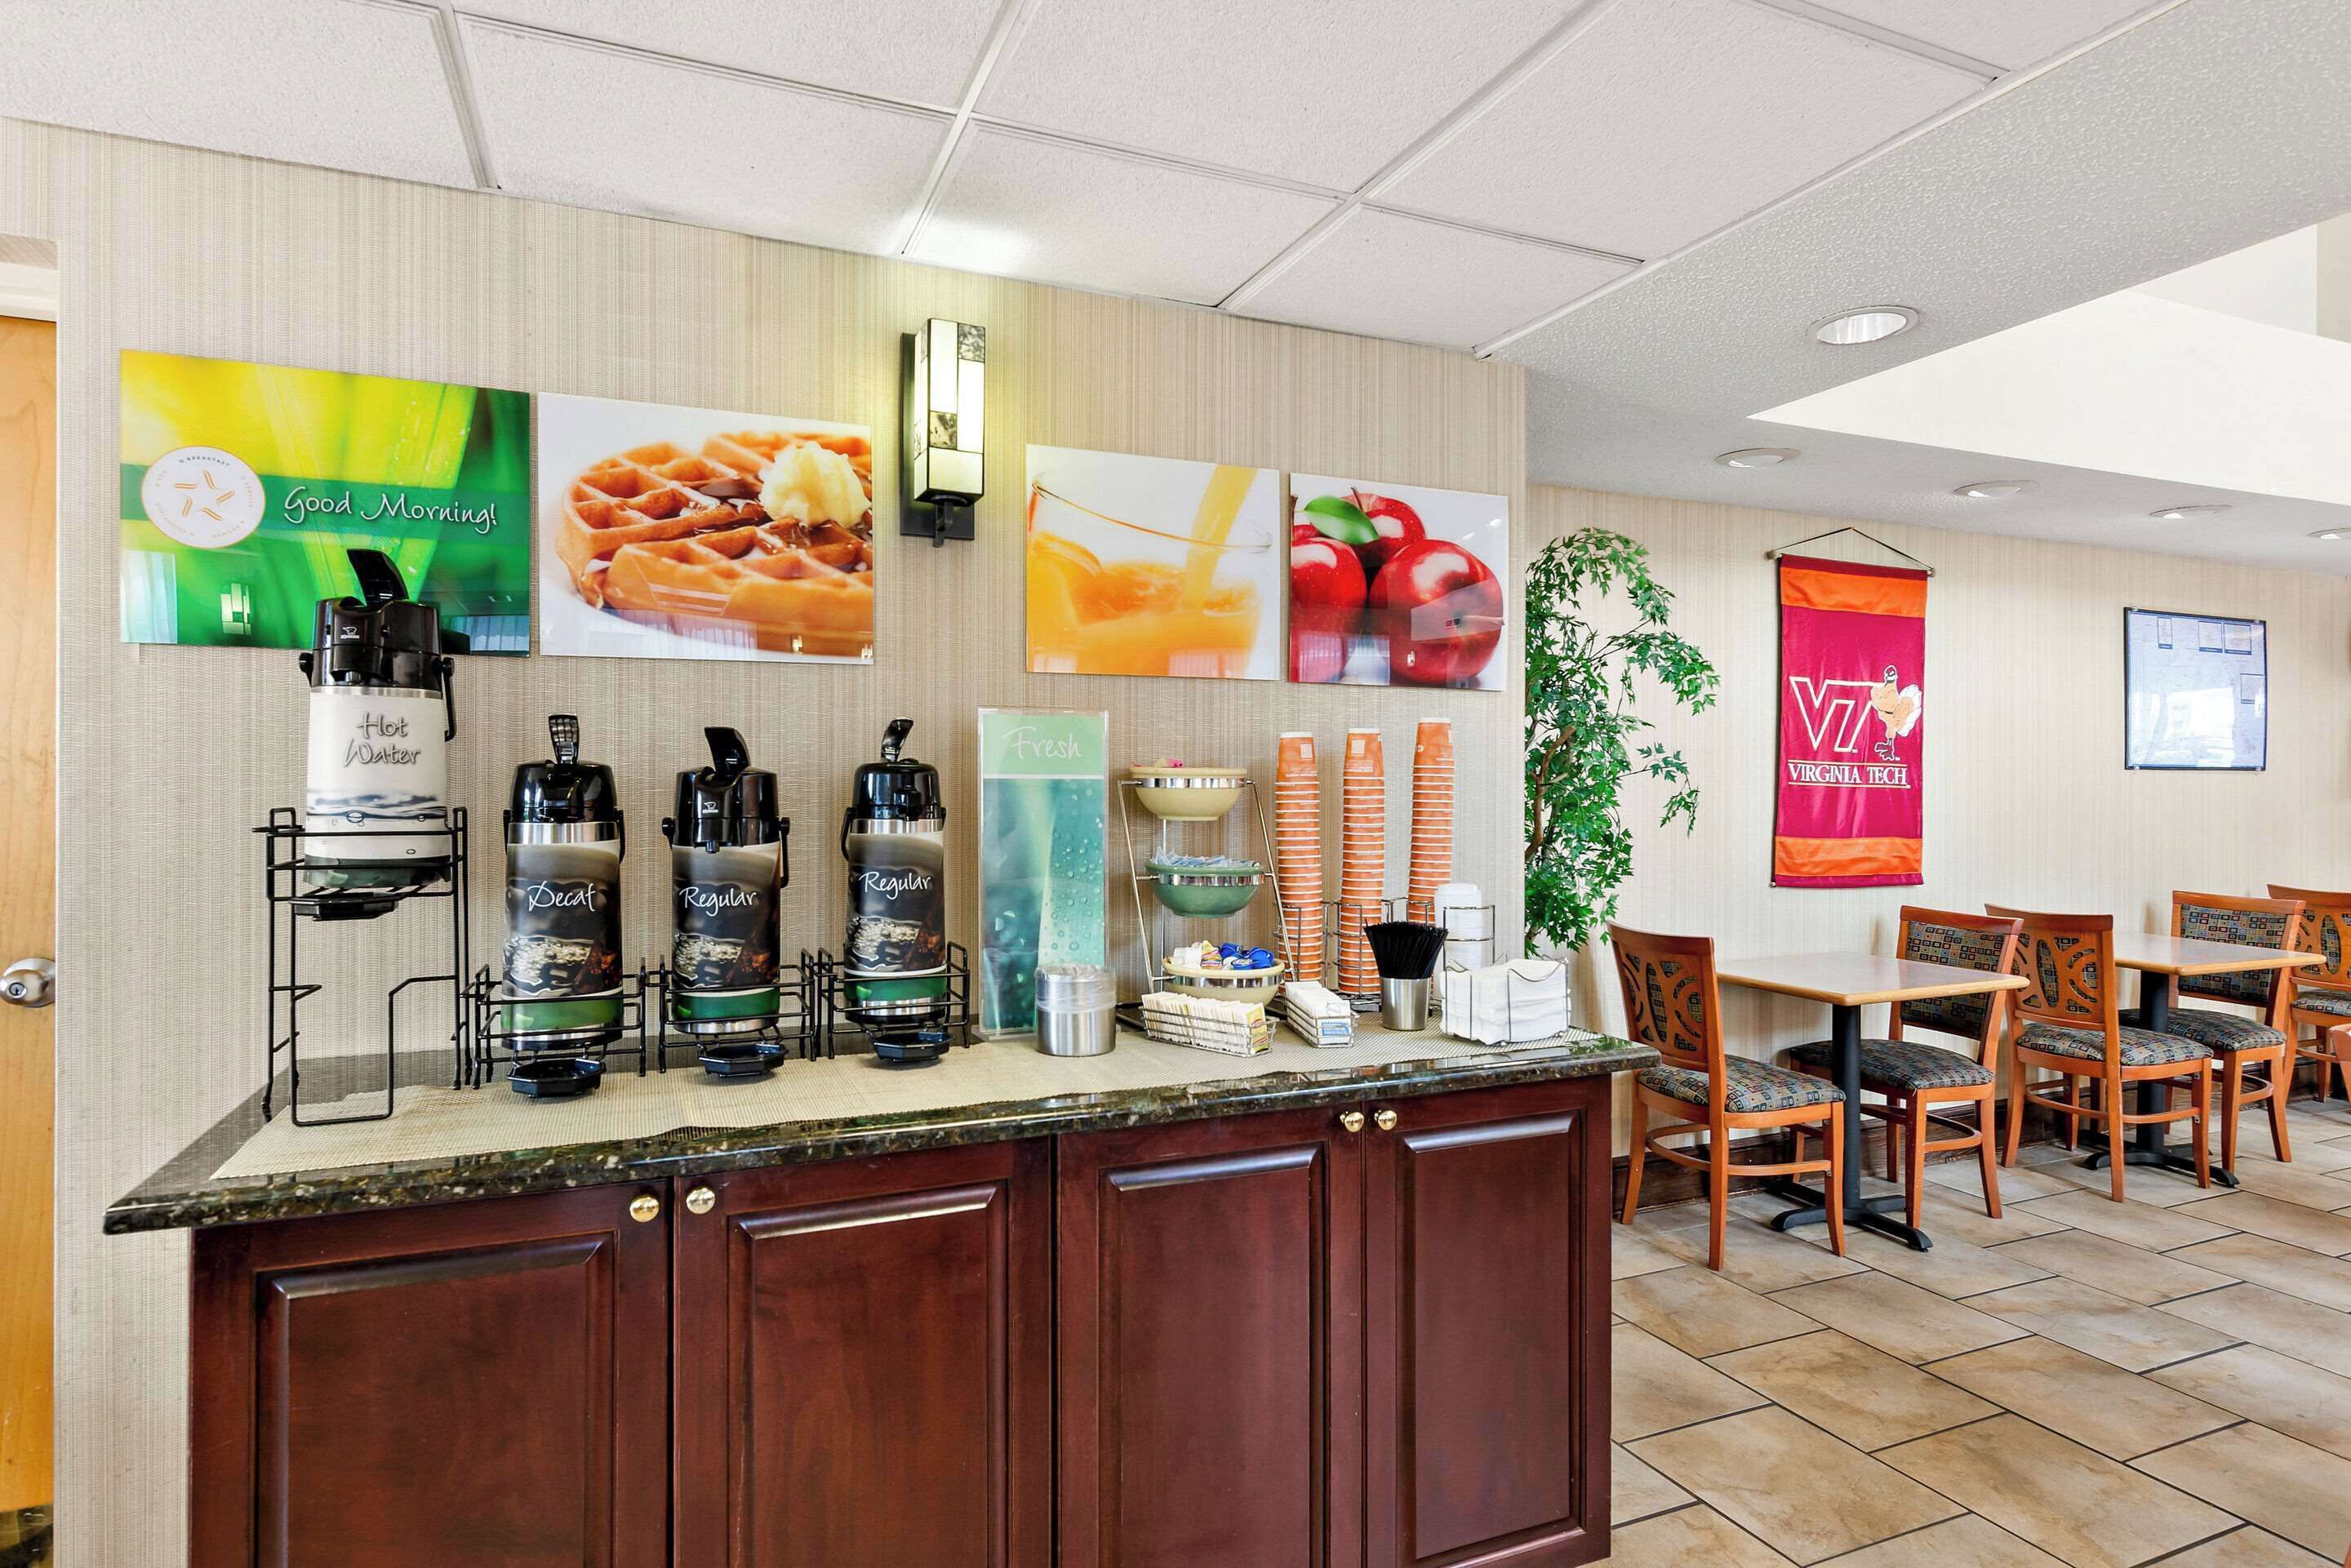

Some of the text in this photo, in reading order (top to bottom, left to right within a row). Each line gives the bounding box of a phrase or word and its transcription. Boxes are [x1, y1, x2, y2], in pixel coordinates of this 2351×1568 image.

[284, 486, 353, 524] Good
[359, 492, 497, 535] Morning!
[356, 711, 409, 740] Hot
[344, 737, 421, 767] Water
[1002, 725, 1082, 760] Fresh
[1788, 762, 1908, 786] VIRGINIA TECH
[527, 881, 596, 913] Decaf
[858, 871, 931, 900] Regular
[678, 886, 758, 917] Regular
